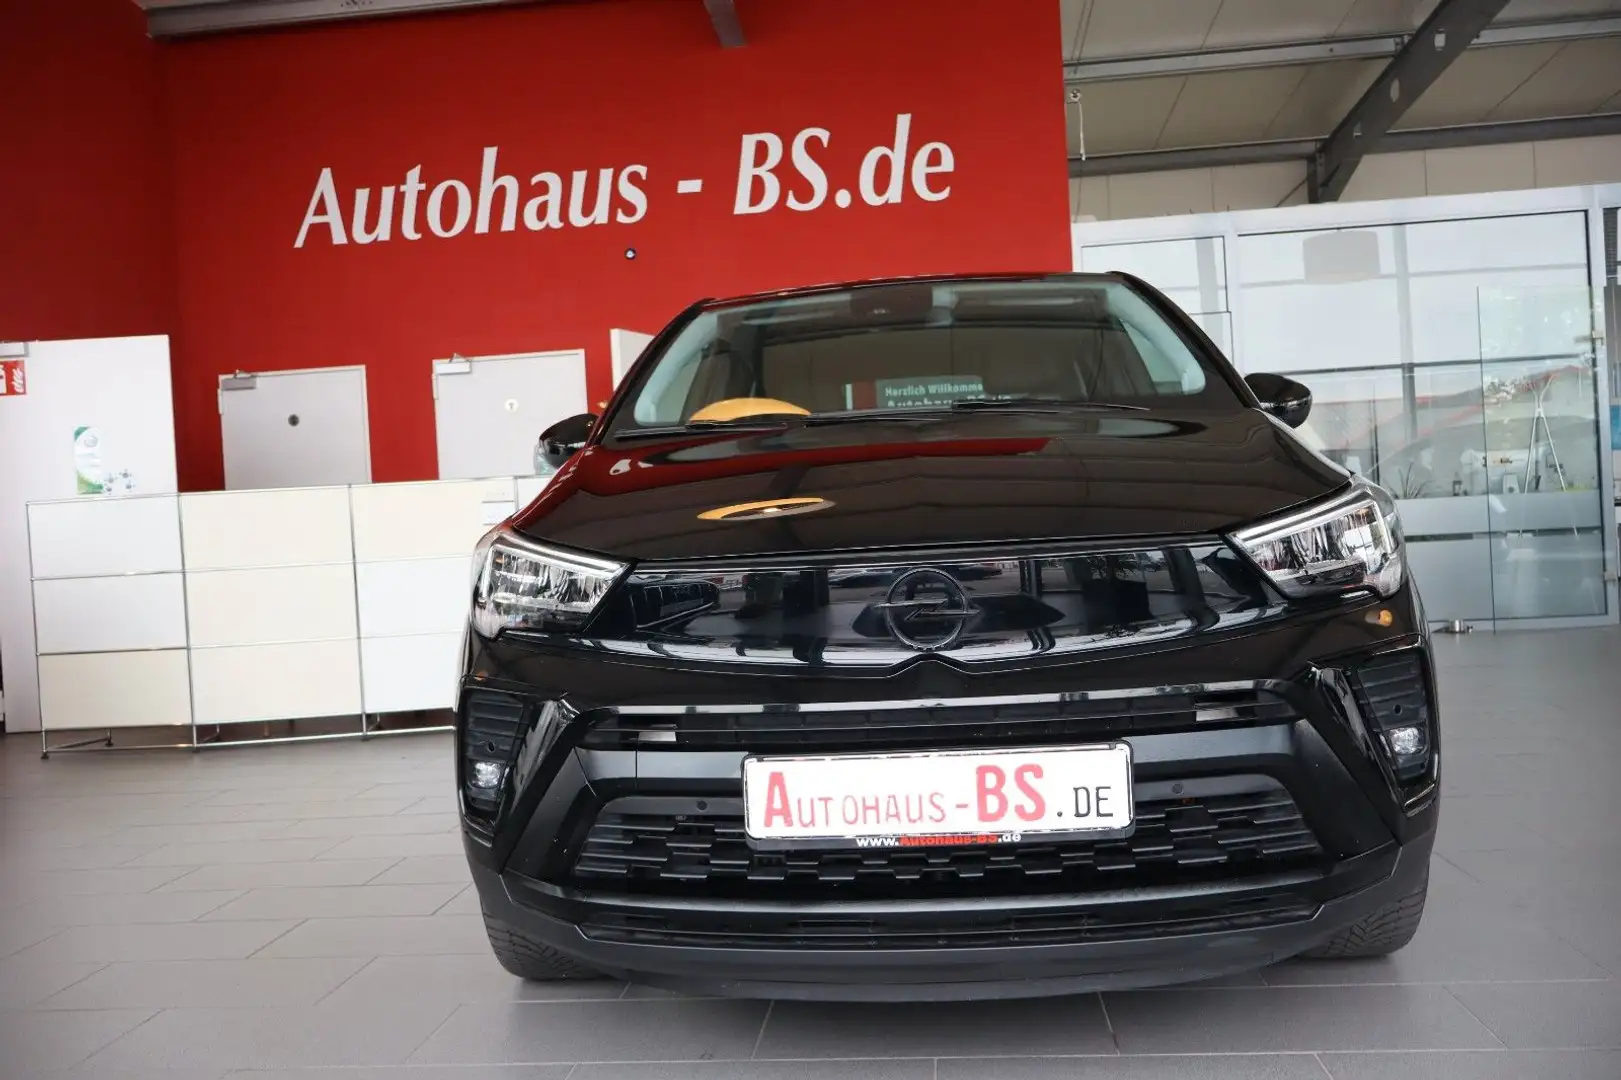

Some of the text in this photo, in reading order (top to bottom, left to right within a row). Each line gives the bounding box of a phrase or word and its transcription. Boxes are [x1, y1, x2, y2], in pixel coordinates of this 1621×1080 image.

[294, 146, 648, 248] Autohaus
[733, 113, 955, 216] BS.de
[885, 385, 926, 397] Herzlich
